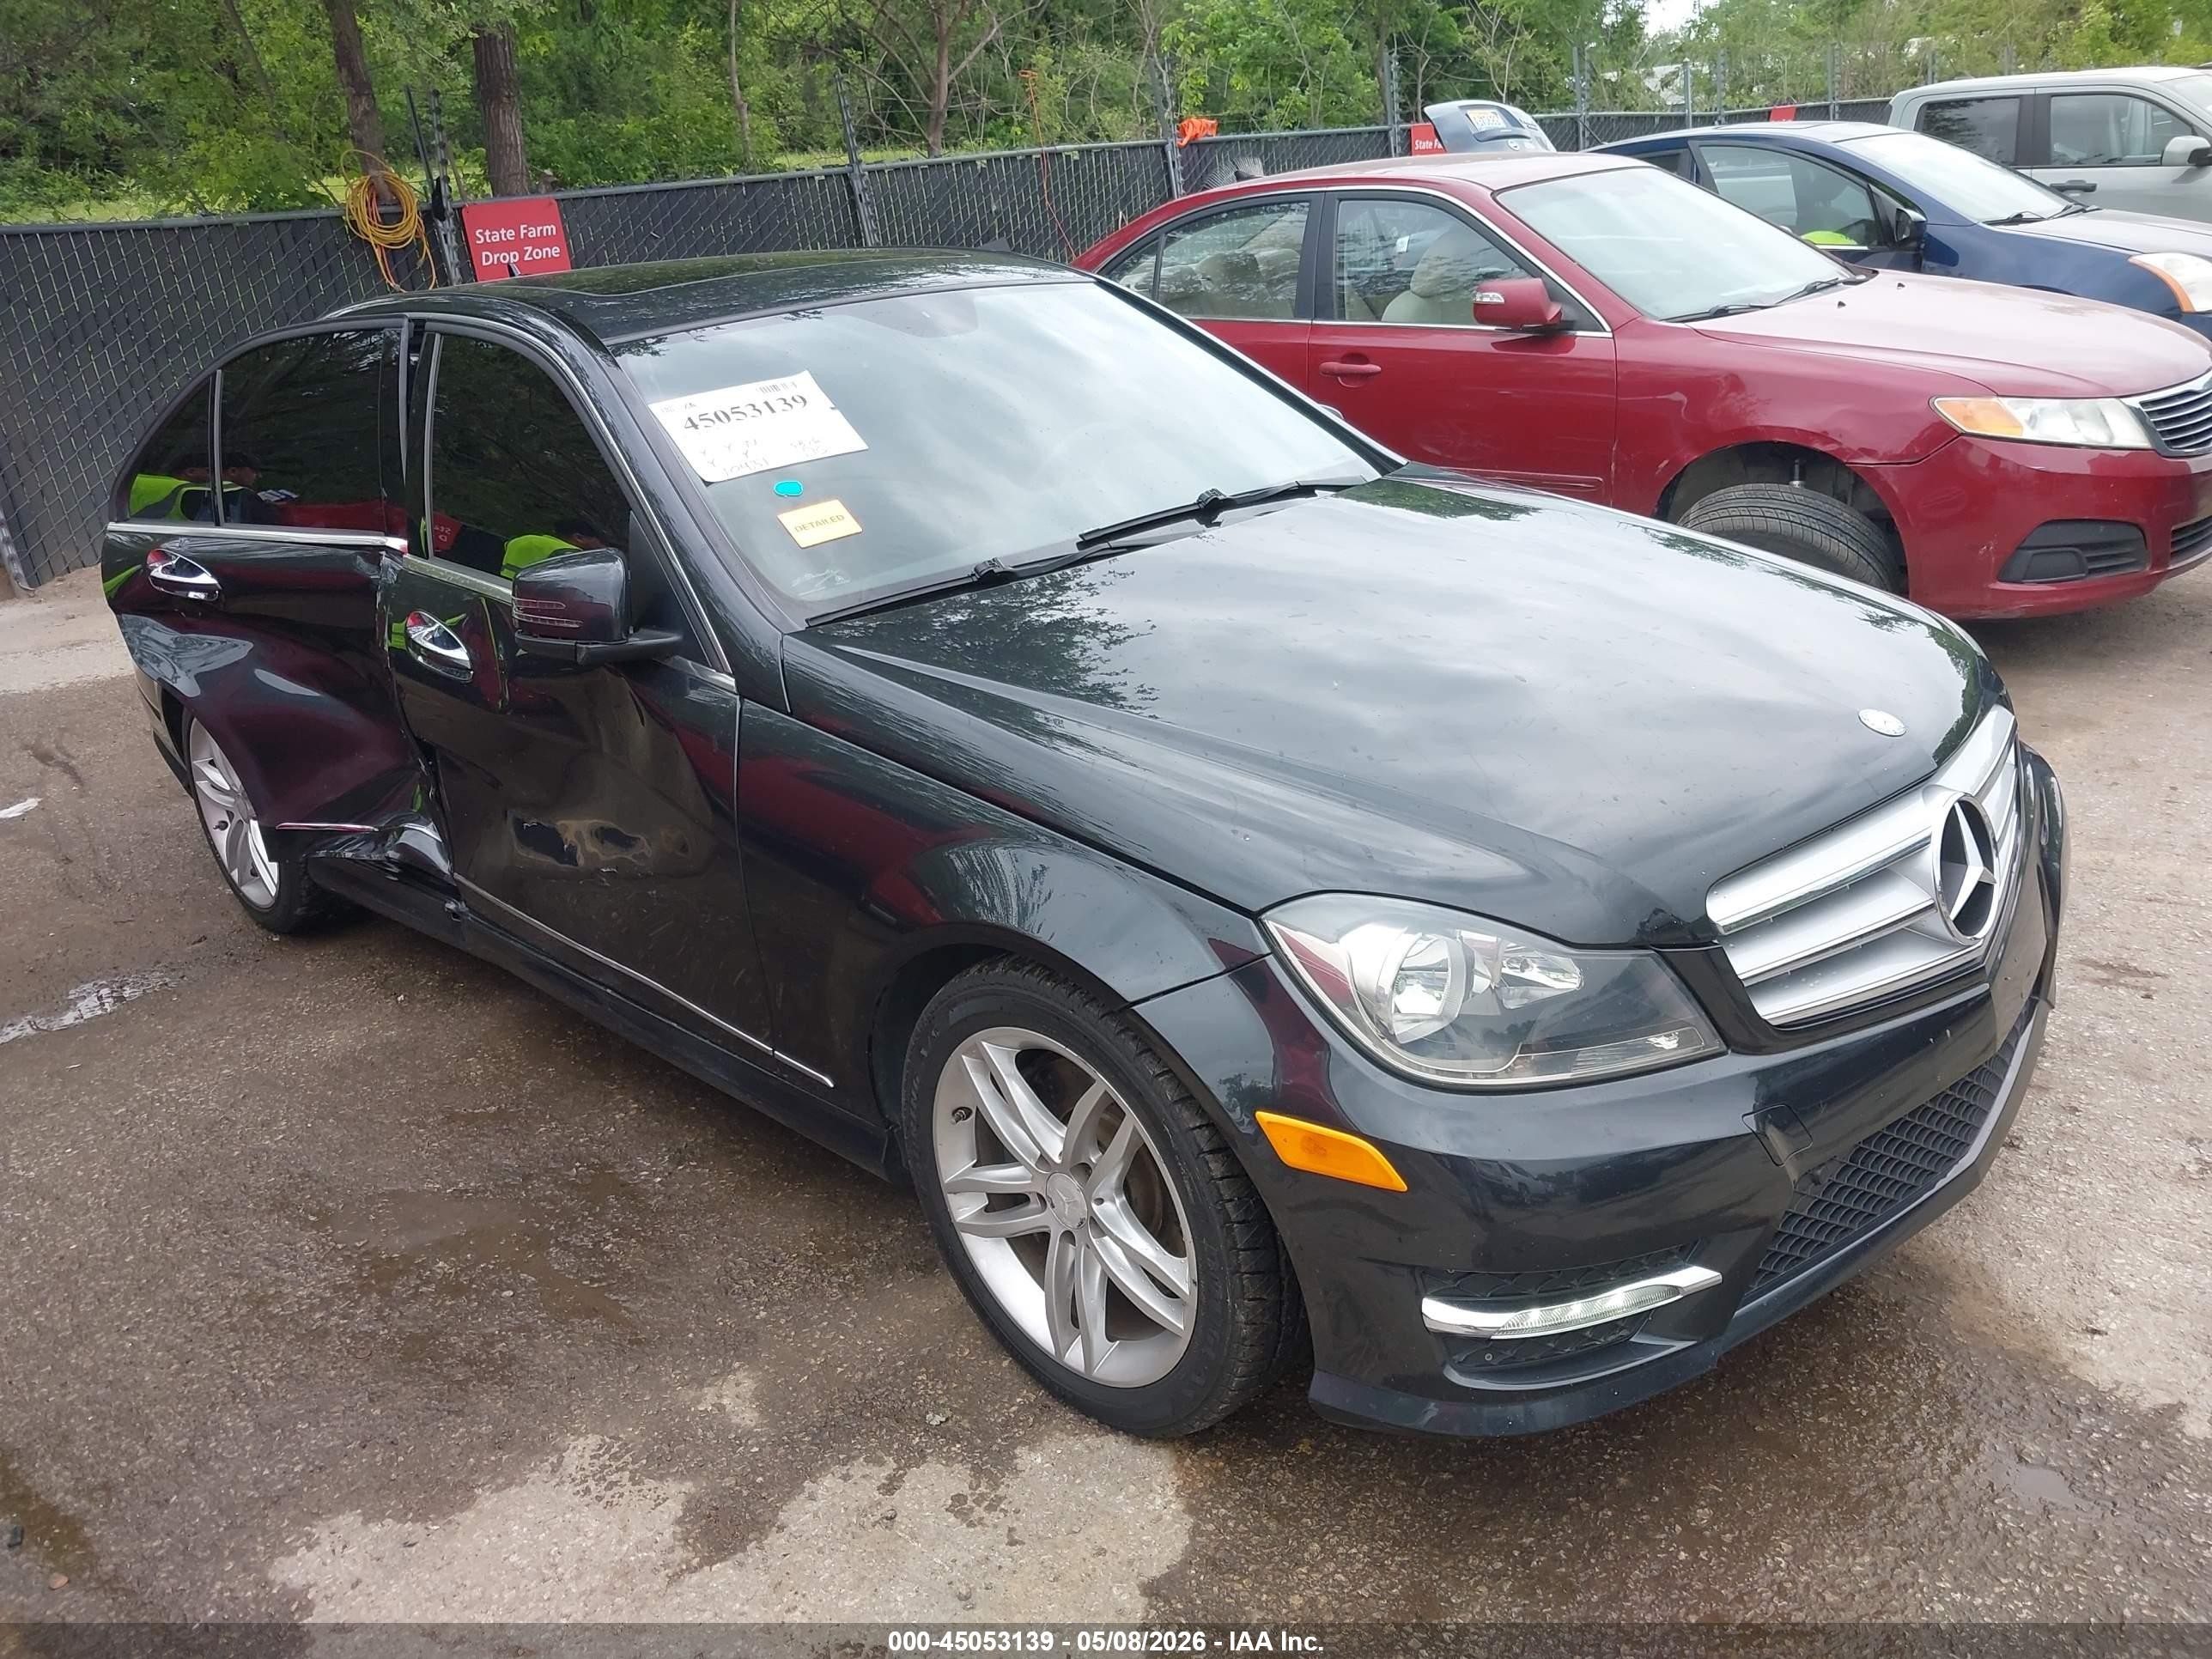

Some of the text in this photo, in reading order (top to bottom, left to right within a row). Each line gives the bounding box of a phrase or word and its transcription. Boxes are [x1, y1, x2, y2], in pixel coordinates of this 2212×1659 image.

[1414, 138, 1443, 150] State Fa
[475, 224, 556, 245] State Farm
[481, 246, 561, 266] Drop Zone
[684, 394, 807, 430] 45053139
[794, 515, 845, 532] DETAILED
